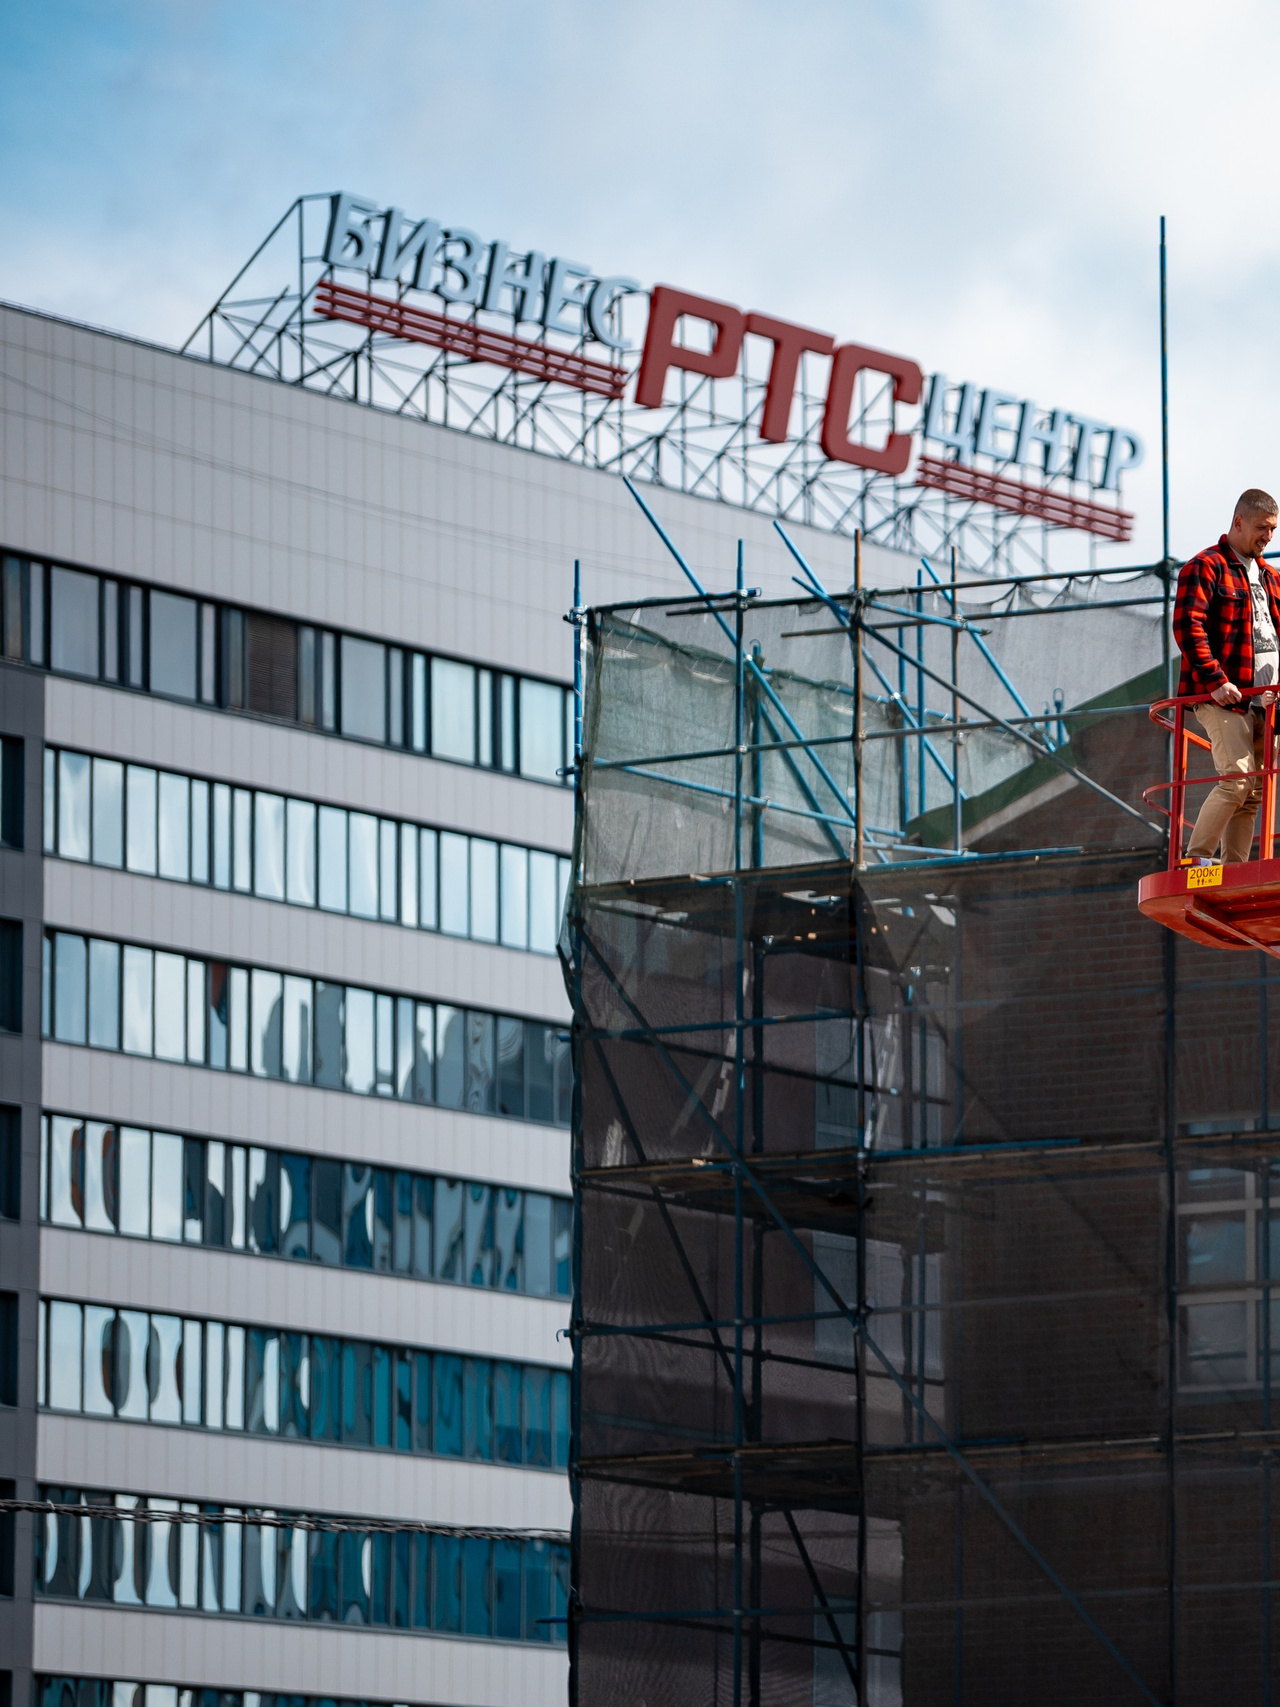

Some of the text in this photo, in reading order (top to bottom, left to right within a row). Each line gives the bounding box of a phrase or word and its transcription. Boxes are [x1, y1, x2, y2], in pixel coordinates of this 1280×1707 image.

[323, 190, 1146, 490] БИЗНЕС РТС ЦЕНТР
